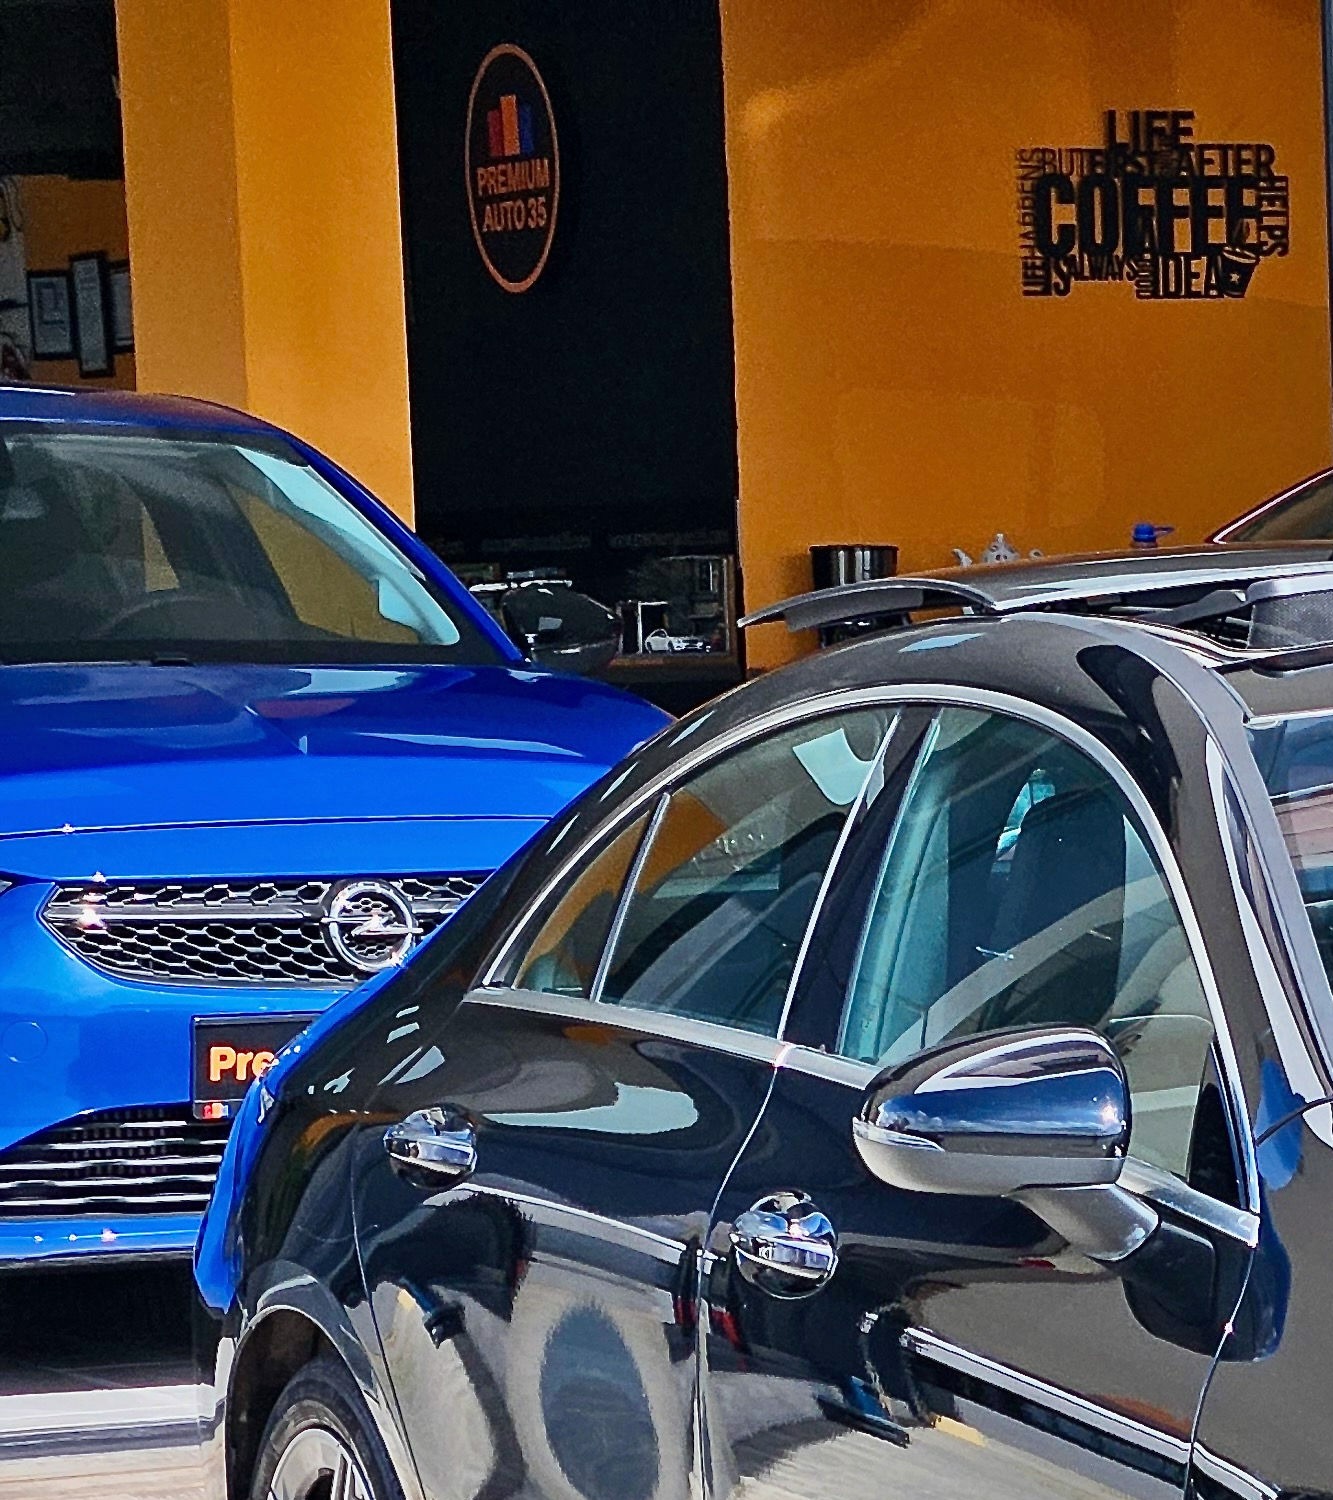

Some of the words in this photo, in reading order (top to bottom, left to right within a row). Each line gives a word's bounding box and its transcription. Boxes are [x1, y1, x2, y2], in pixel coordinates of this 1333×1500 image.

[1104, 109, 1195, 148] LIFE
[477, 157, 549, 196] PREMIUM
[1172, 142, 1276, 178] AFTER
[483, 201, 526, 232] AUTO
[527, 197, 547, 228] 35
[1033, 173, 1260, 255] COFFEE
